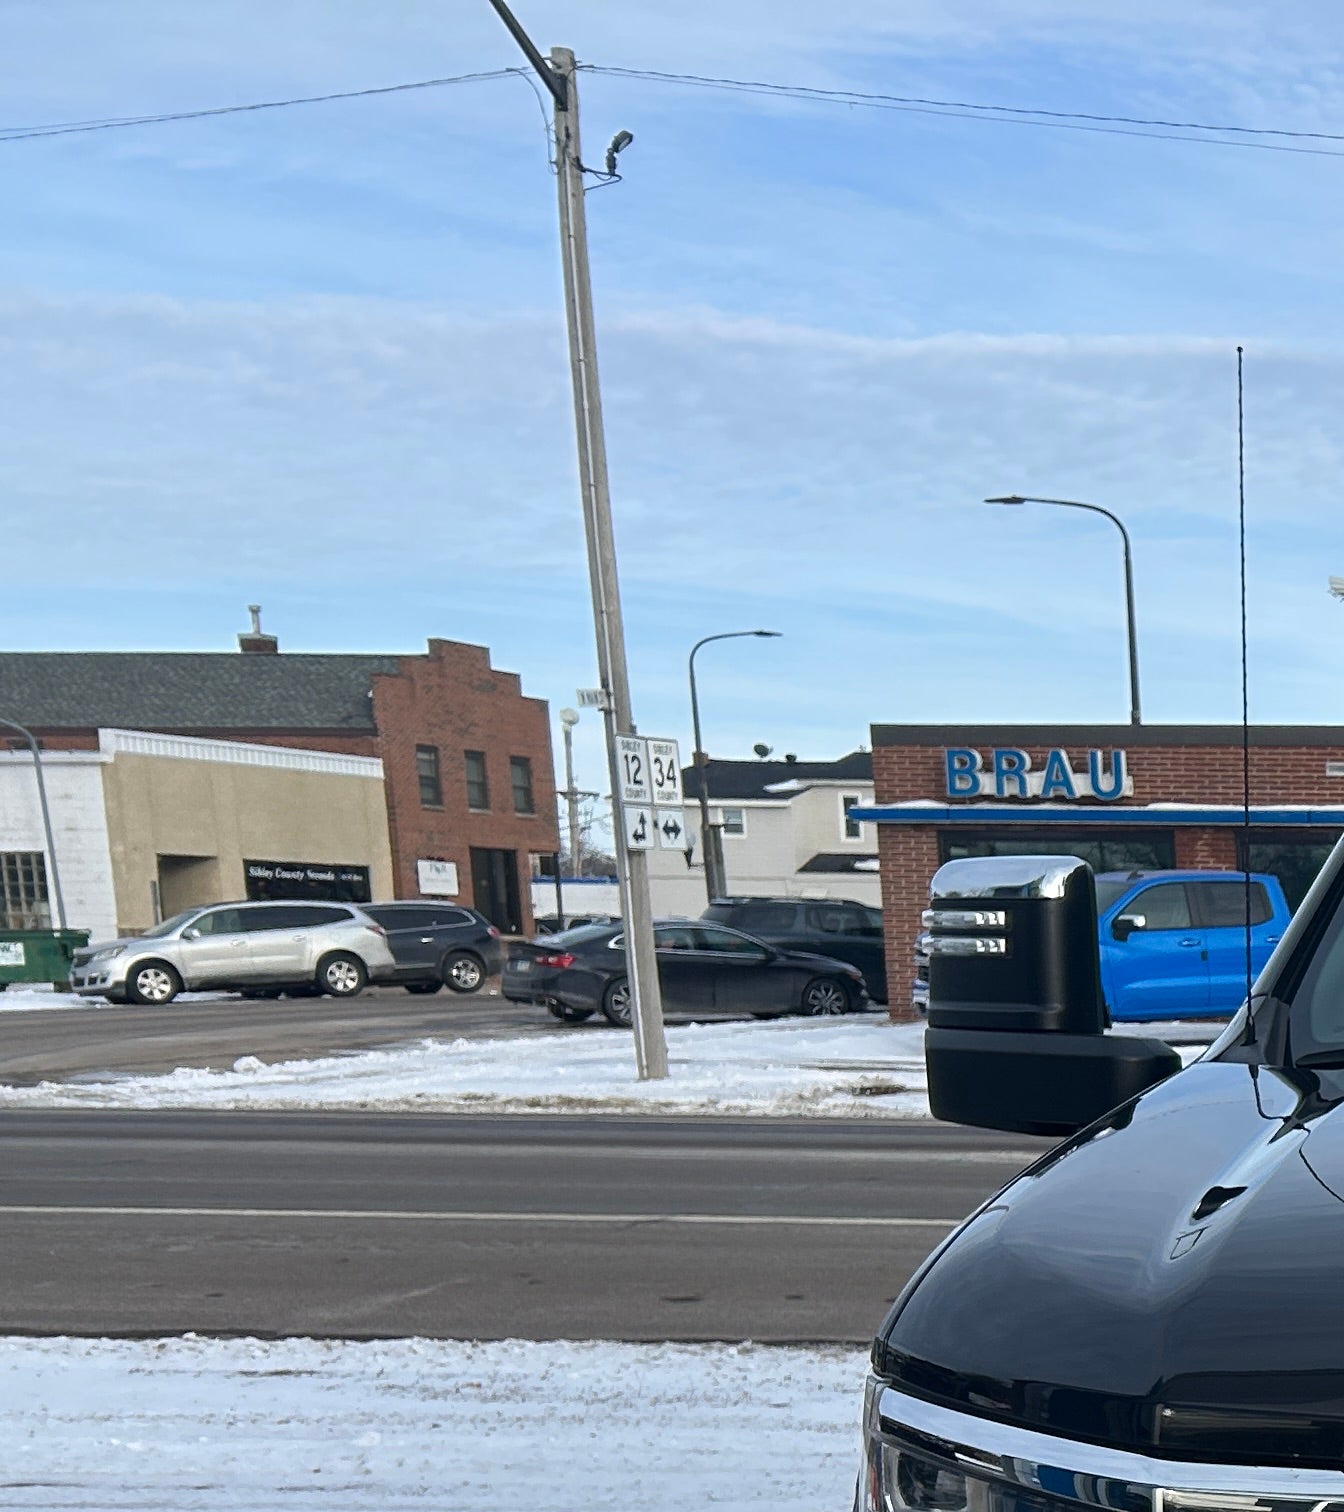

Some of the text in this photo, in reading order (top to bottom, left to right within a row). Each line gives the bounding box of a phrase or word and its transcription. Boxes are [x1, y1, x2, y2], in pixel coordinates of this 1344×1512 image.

[624, 753, 643, 785] 12
[654, 757, 676, 788] 34
[945, 747, 1127, 800] BRAU
